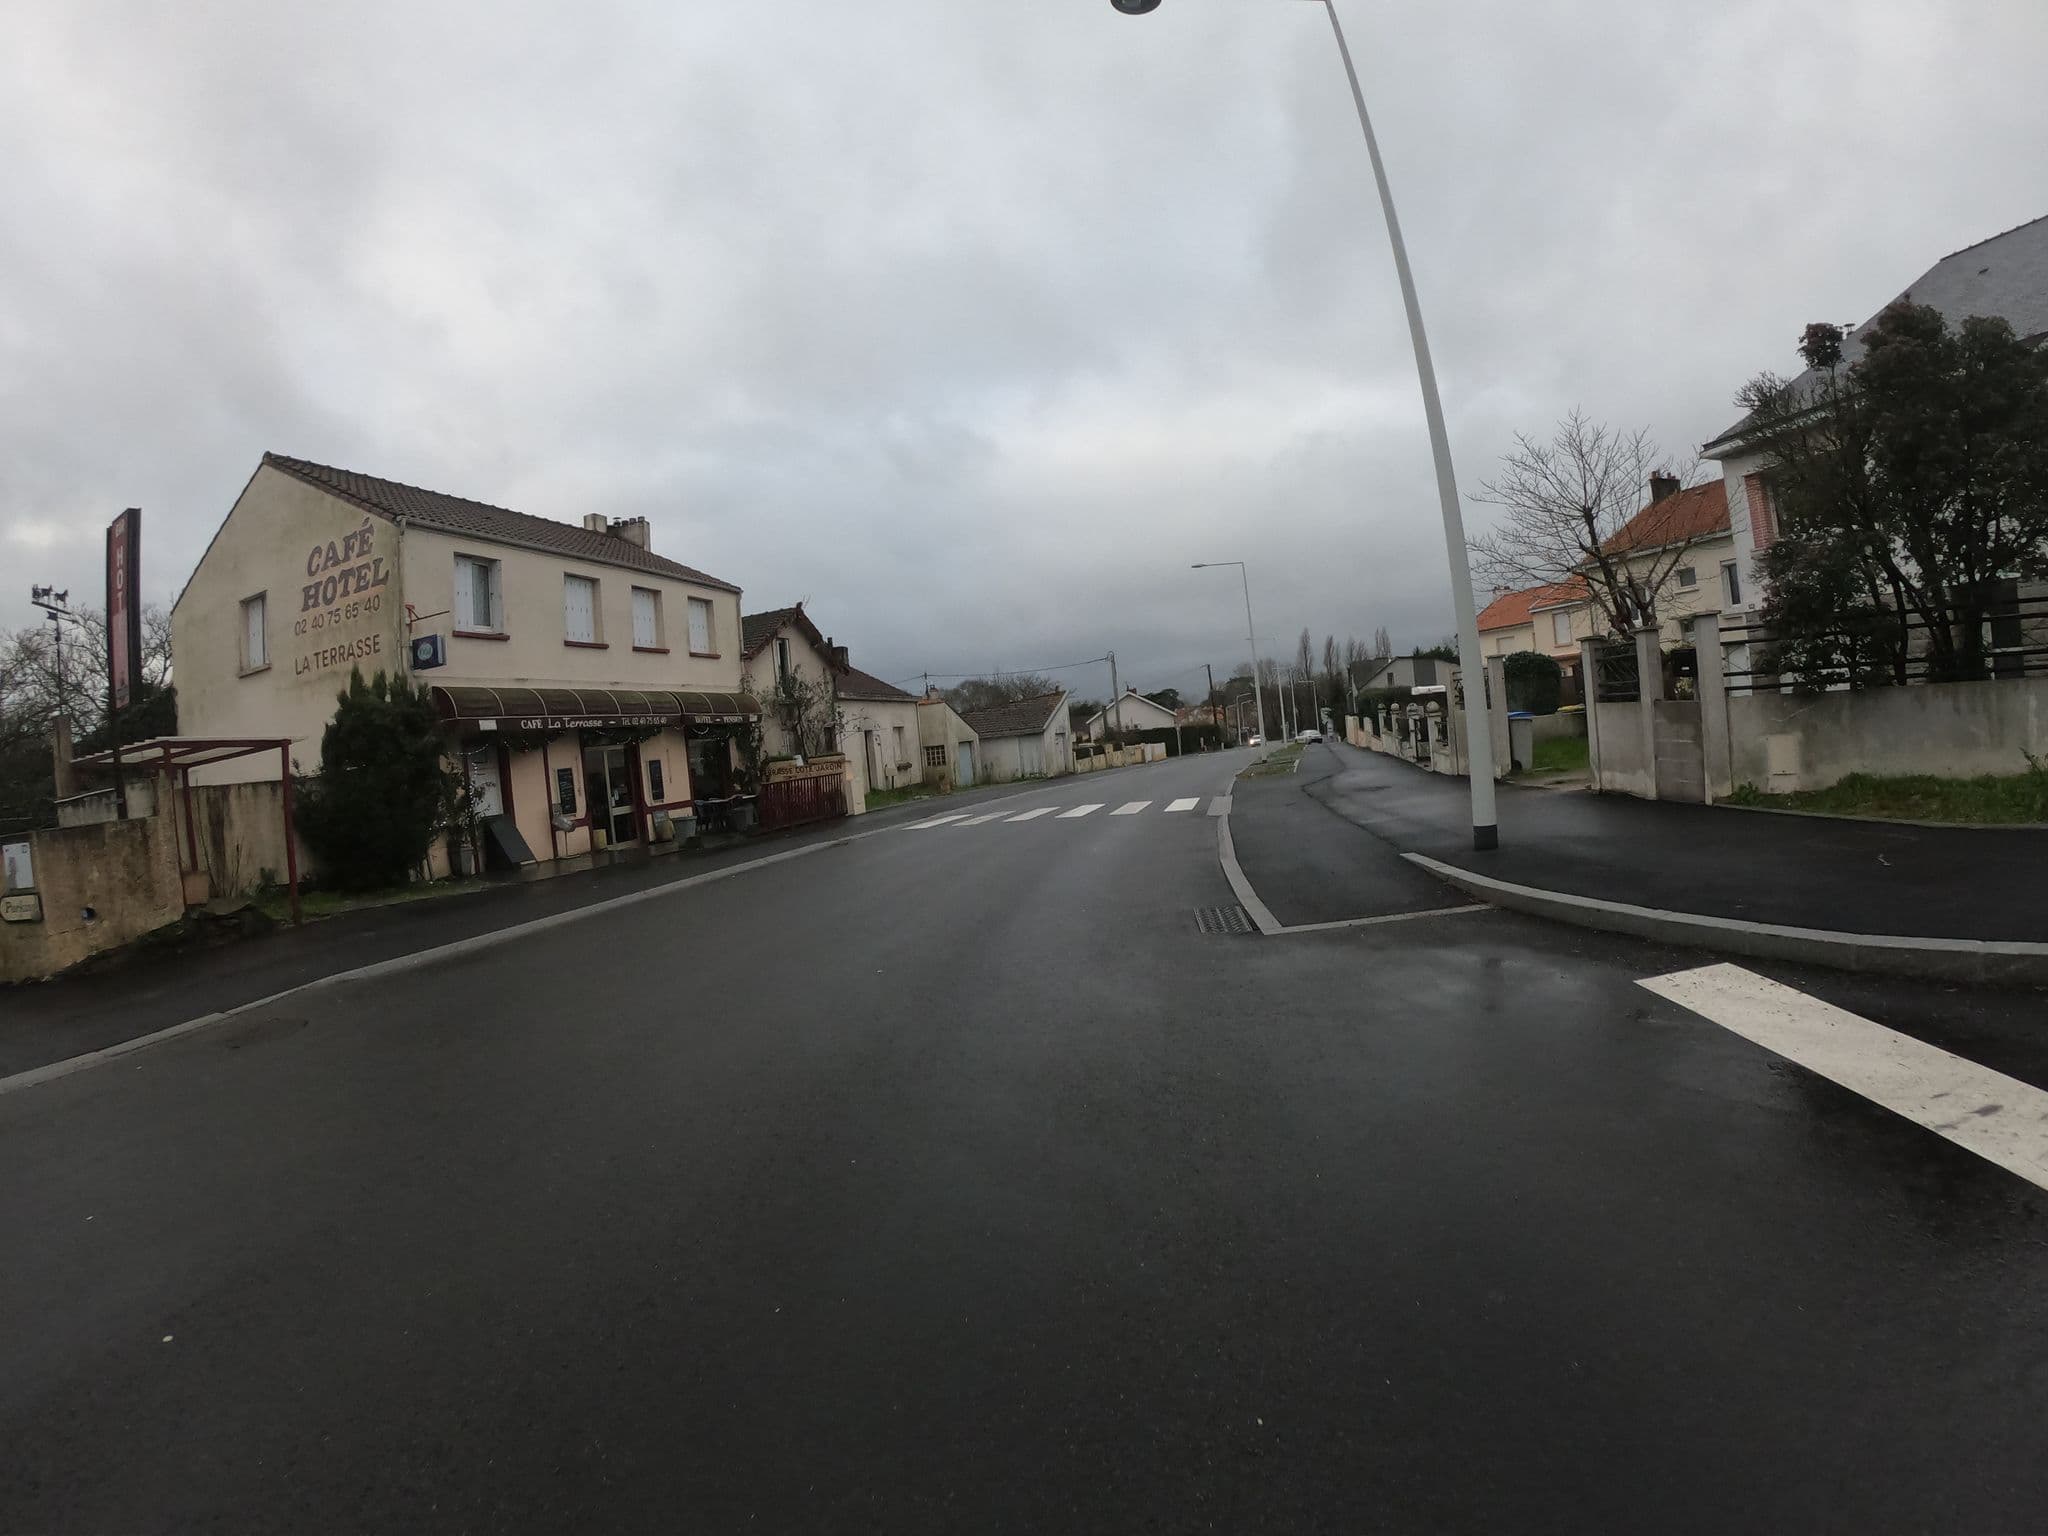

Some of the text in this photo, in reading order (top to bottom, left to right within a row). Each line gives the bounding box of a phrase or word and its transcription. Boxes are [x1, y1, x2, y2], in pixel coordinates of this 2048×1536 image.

[307, 517, 374, 577] CAFÉ
[301, 557, 390, 612] HOTEL
[295, 619, 307, 636] 02
[311, 613, 324, 631] 40
[327, 607, 341, 625] 75
[364, 594, 381, 612] 40
[295, 633, 381, 676] LA TERRASSE
[547, 717, 561, 728] La
[562, 717, 603, 728] Terrasse
